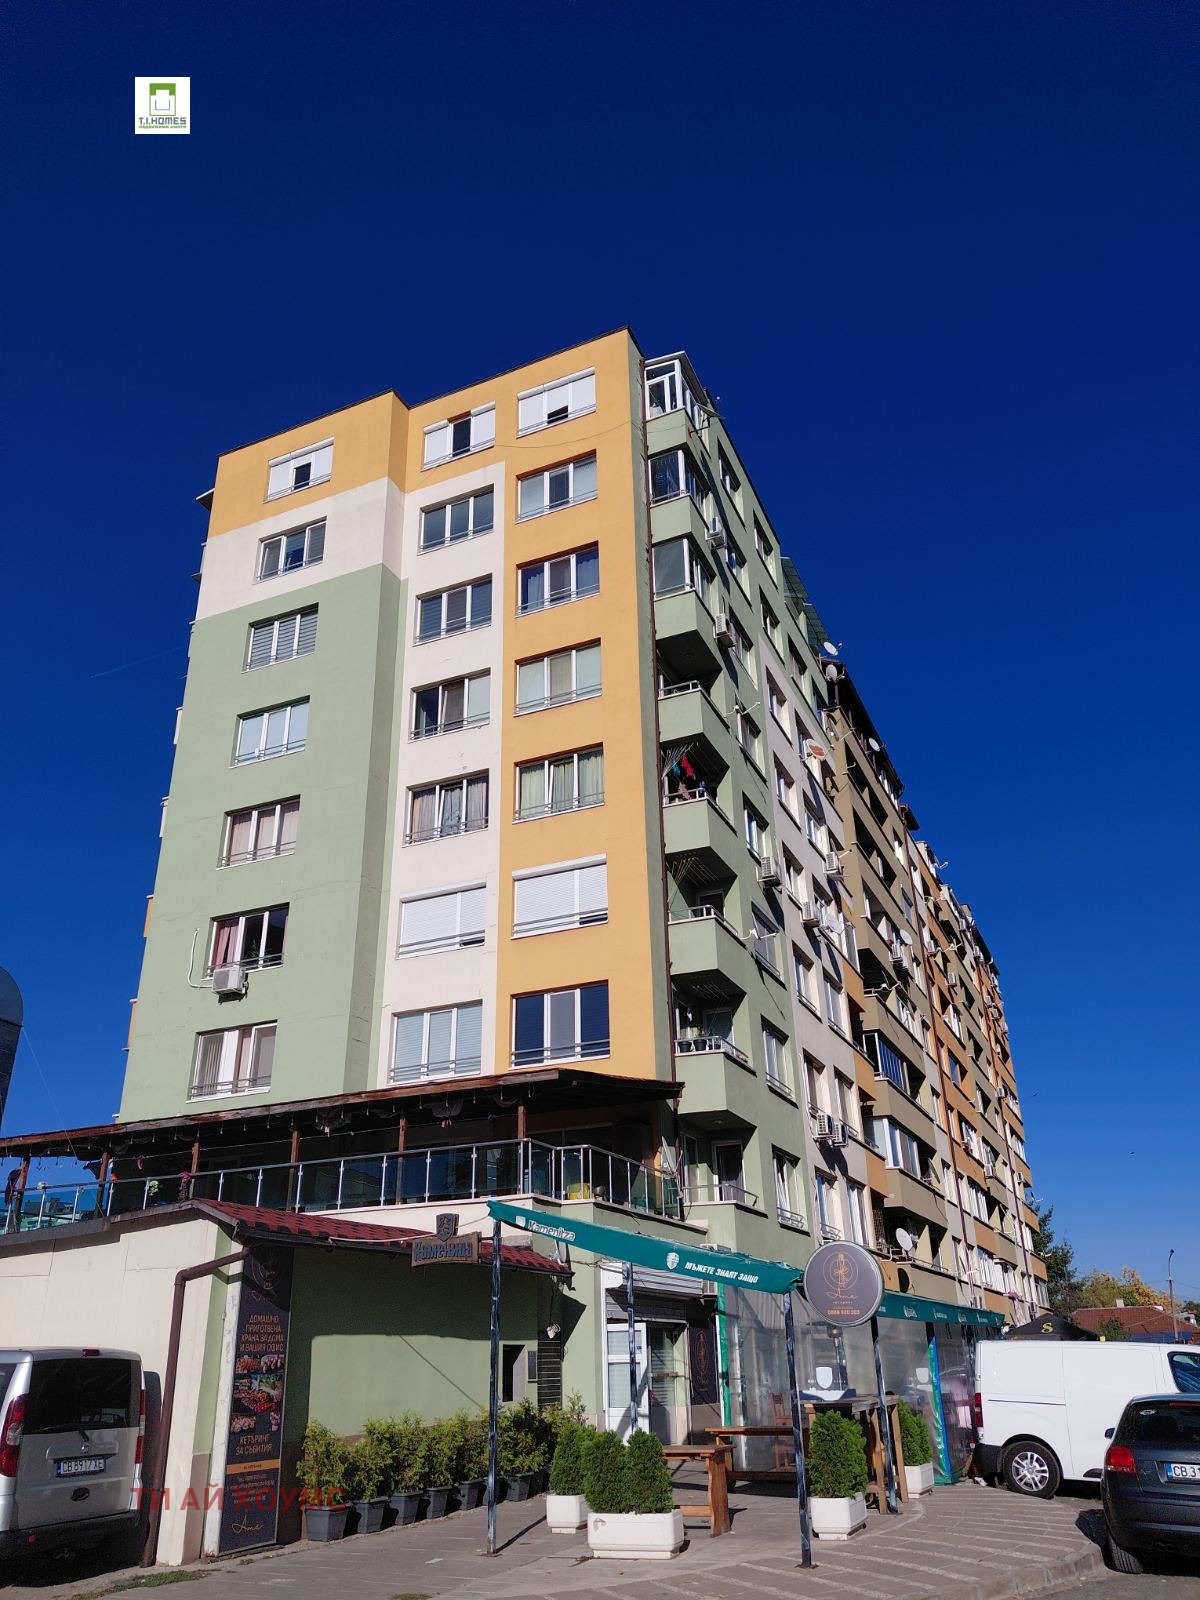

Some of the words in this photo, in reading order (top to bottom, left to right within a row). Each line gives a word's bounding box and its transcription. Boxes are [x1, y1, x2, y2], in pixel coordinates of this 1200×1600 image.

[528, 1219, 576, 1242] Kamenitza
[684, 1262, 715, 1275] МЪЖЕТЕ
[715, 1268, 738, 1279] ЗНАЯТ
[738, 1272, 759, 1283] ЗАЩО
[249, 1314, 279, 1324] ДОМАШНО
[1173, 1465, 1188, 1477] CB
